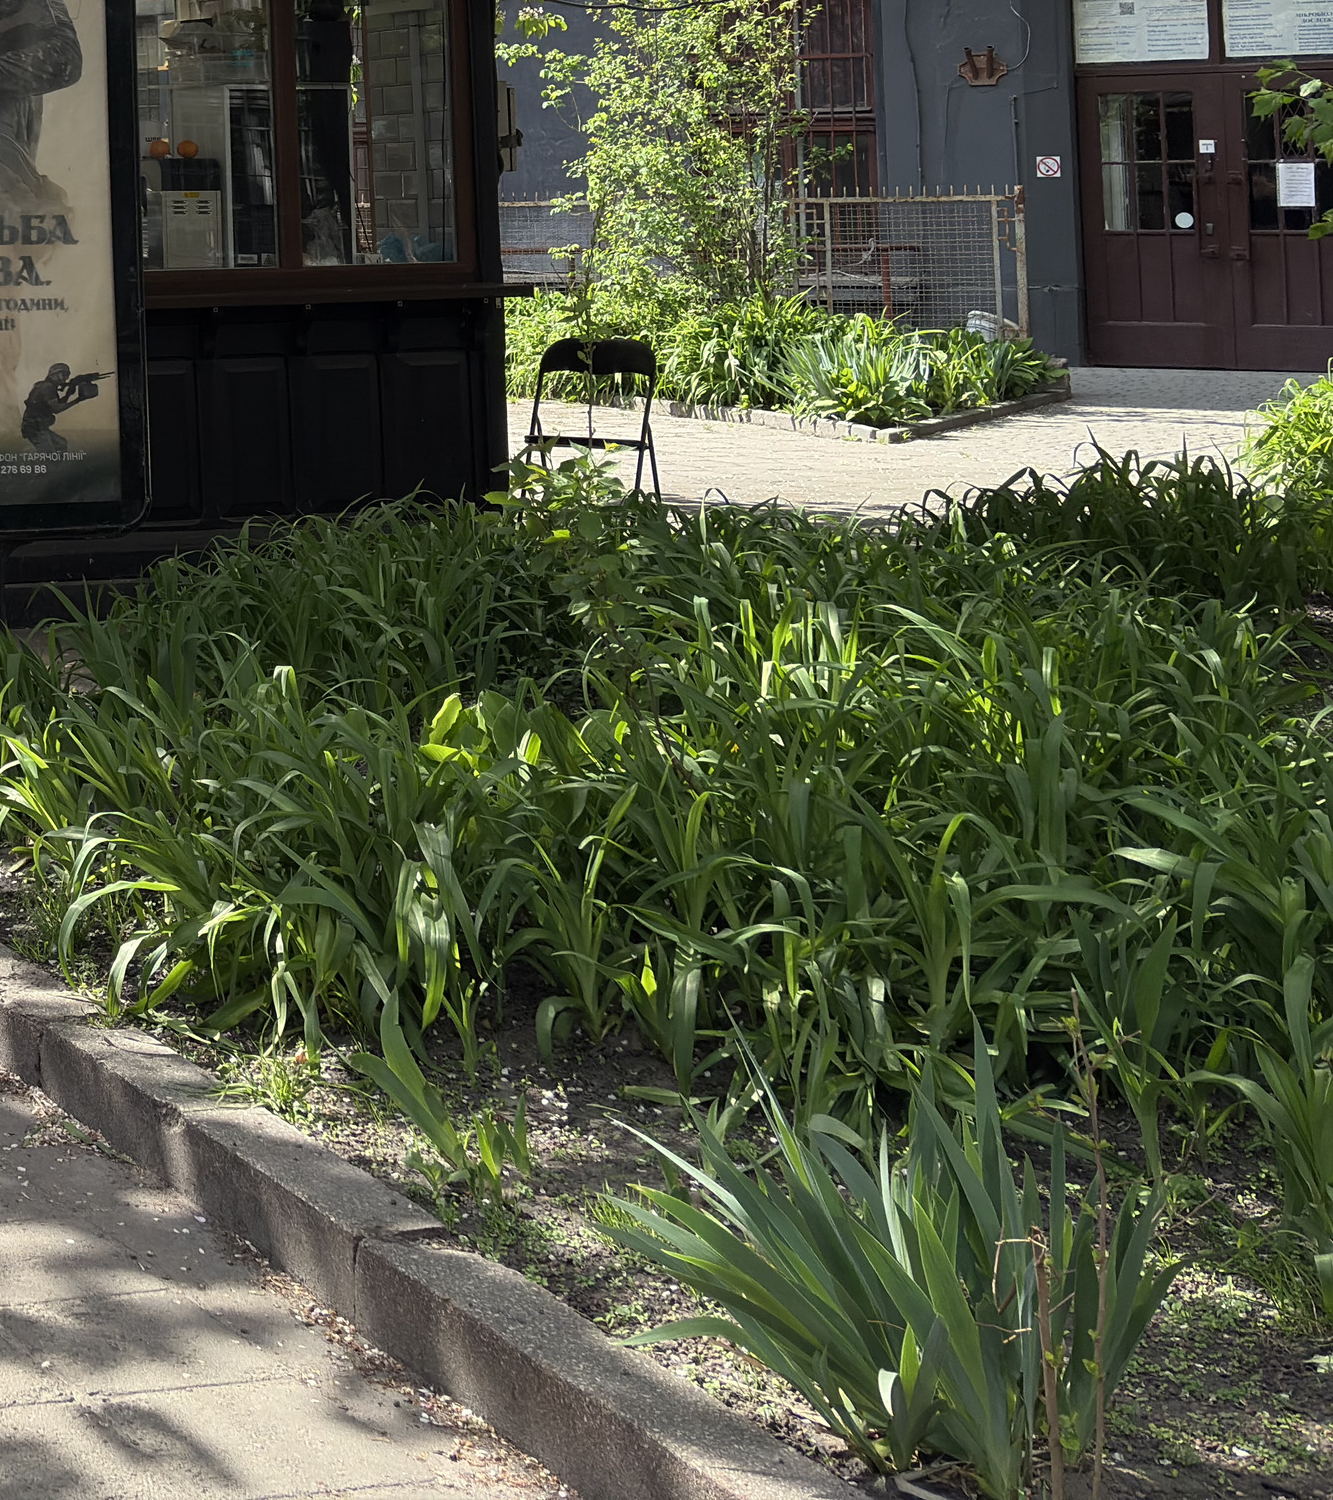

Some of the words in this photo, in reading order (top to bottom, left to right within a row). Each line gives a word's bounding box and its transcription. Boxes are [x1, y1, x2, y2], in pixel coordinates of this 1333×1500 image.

[0, 465, 18, 474] 276
[19, 465, 32, 474] 69
[34, 465, 47, 474] 86
